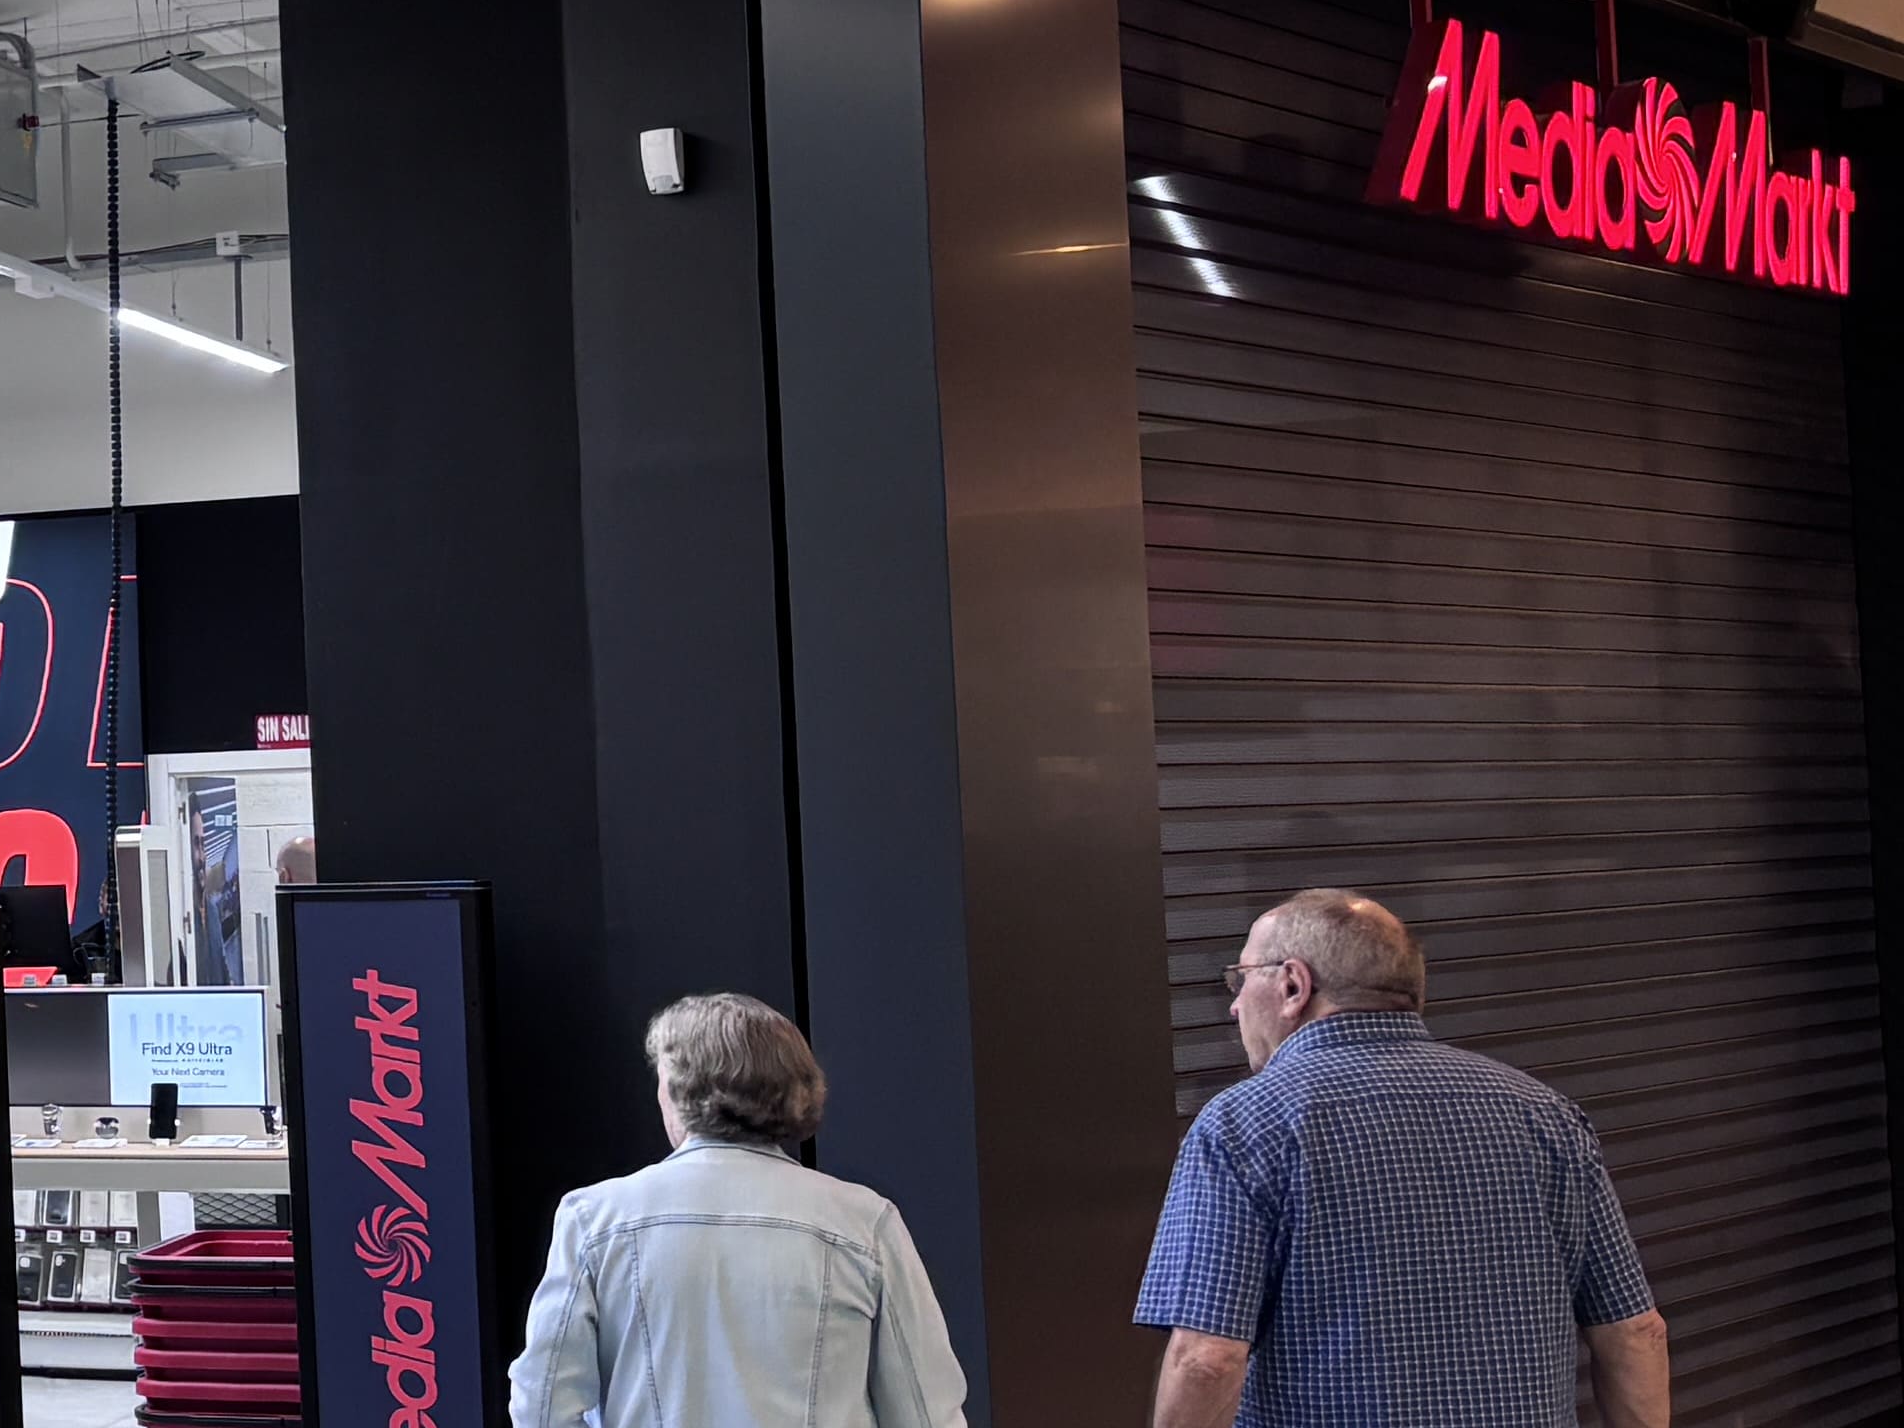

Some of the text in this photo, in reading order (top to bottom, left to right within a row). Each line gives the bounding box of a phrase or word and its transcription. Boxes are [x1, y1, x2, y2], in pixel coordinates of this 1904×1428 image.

[1401, 18, 1855, 295] Media Markt
[257, 714, 310, 742] SIN SALI
[142, 1042, 232, 1056] Find X9 Ultra
[349, 969, 429, 1217] Markt
